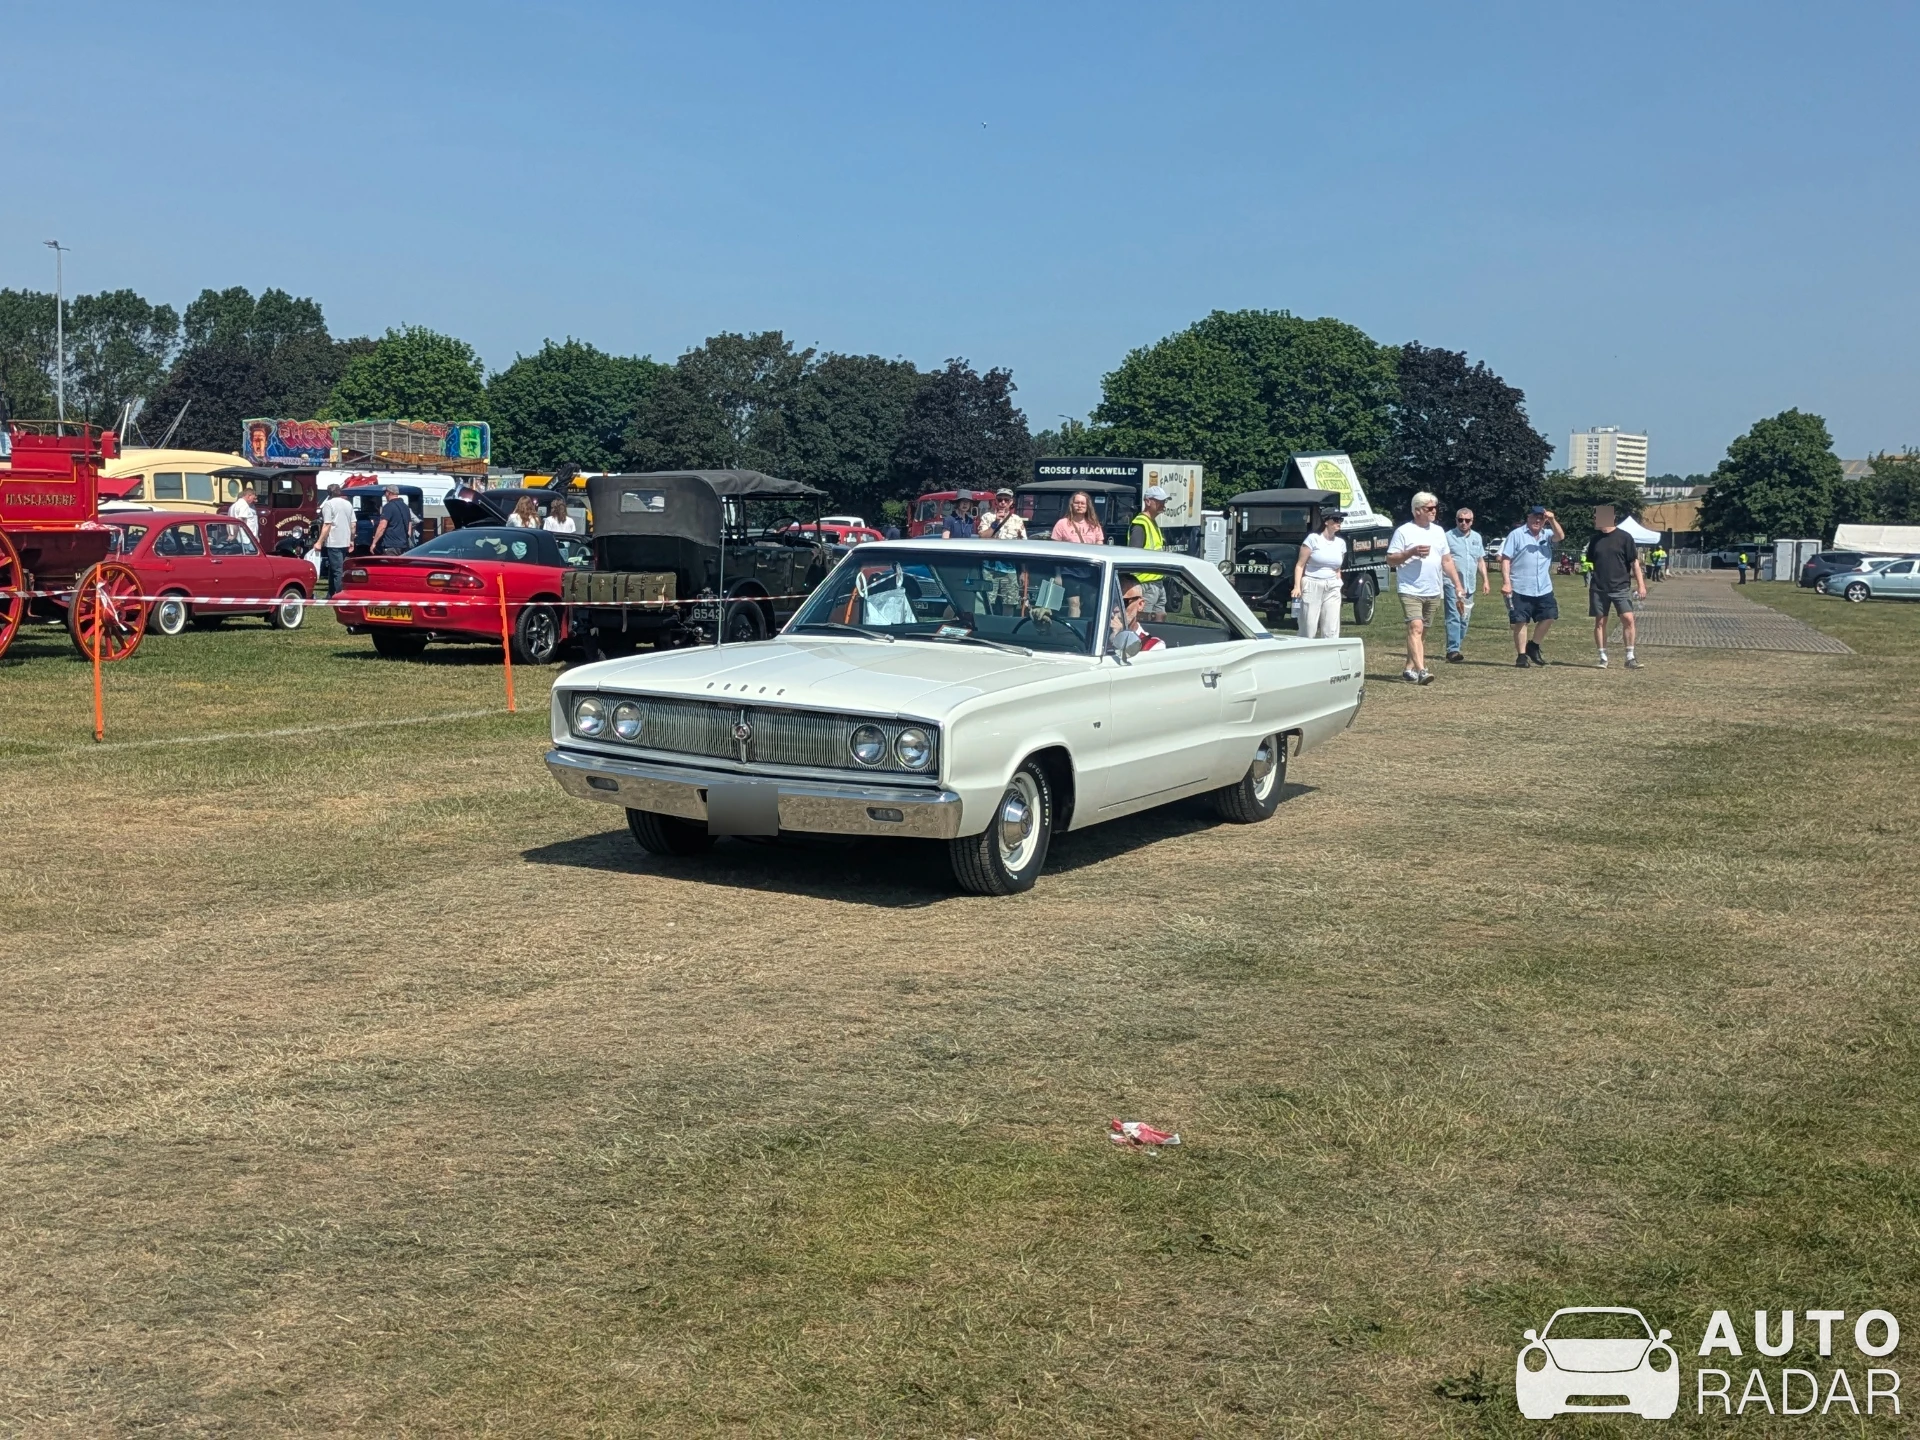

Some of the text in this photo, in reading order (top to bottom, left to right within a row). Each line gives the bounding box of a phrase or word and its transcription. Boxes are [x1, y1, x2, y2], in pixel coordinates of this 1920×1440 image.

[1039, 466, 1071, 475] CROSSE
[1072, 466, 1079, 475] &
[1080, 467, 1127, 475] BLACKWELL
[1160, 472, 1188, 488] FAMOUS
[5, 493, 76, 506] HASLEMERE
[1235, 565, 1247, 573] NT
[368, 606, 393, 617] V604
[693, 609, 722, 620] 6543
